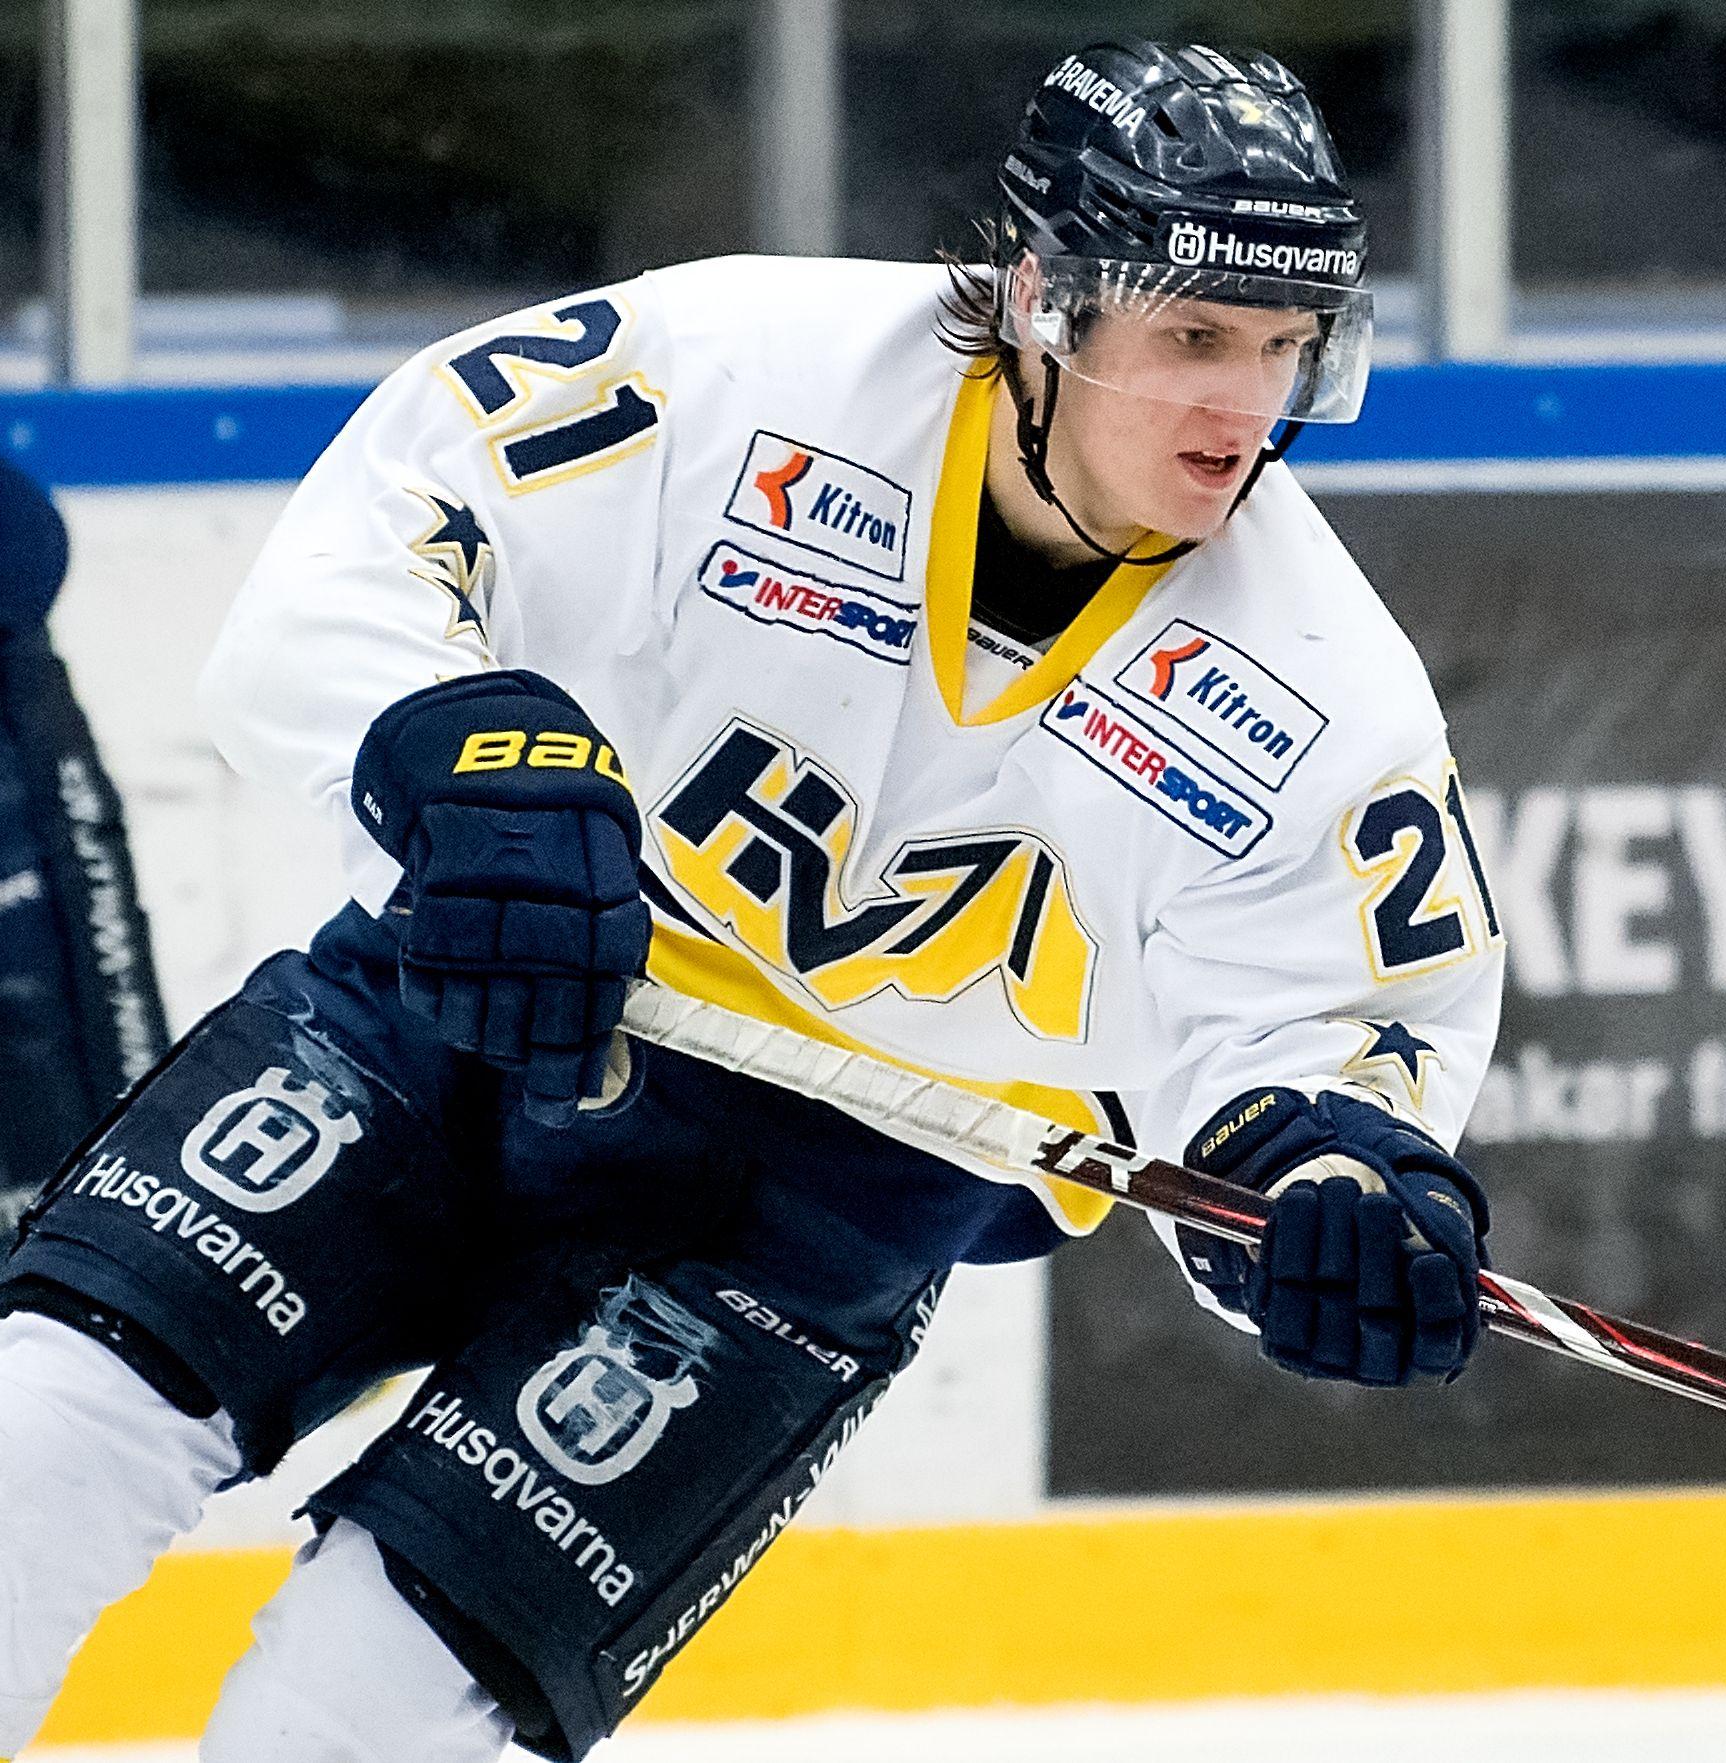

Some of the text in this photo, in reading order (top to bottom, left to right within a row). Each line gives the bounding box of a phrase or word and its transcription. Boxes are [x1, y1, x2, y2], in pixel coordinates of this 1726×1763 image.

[1207, 231, 1358, 275] Husqvarna
[446, 297, 661, 482] 21
[807, 482, 898, 552] Kitron
[754, 577, 918, 650] INTERSPORT
[1083, 707, 1252, 840] INTERSPORT
[1187, 665, 1296, 761] Kitron
[654, 724, 1058, 985] HV71
[73, 1153, 307, 1337] Husqvarna
[407, 1391, 636, 1608] Husqvarna
